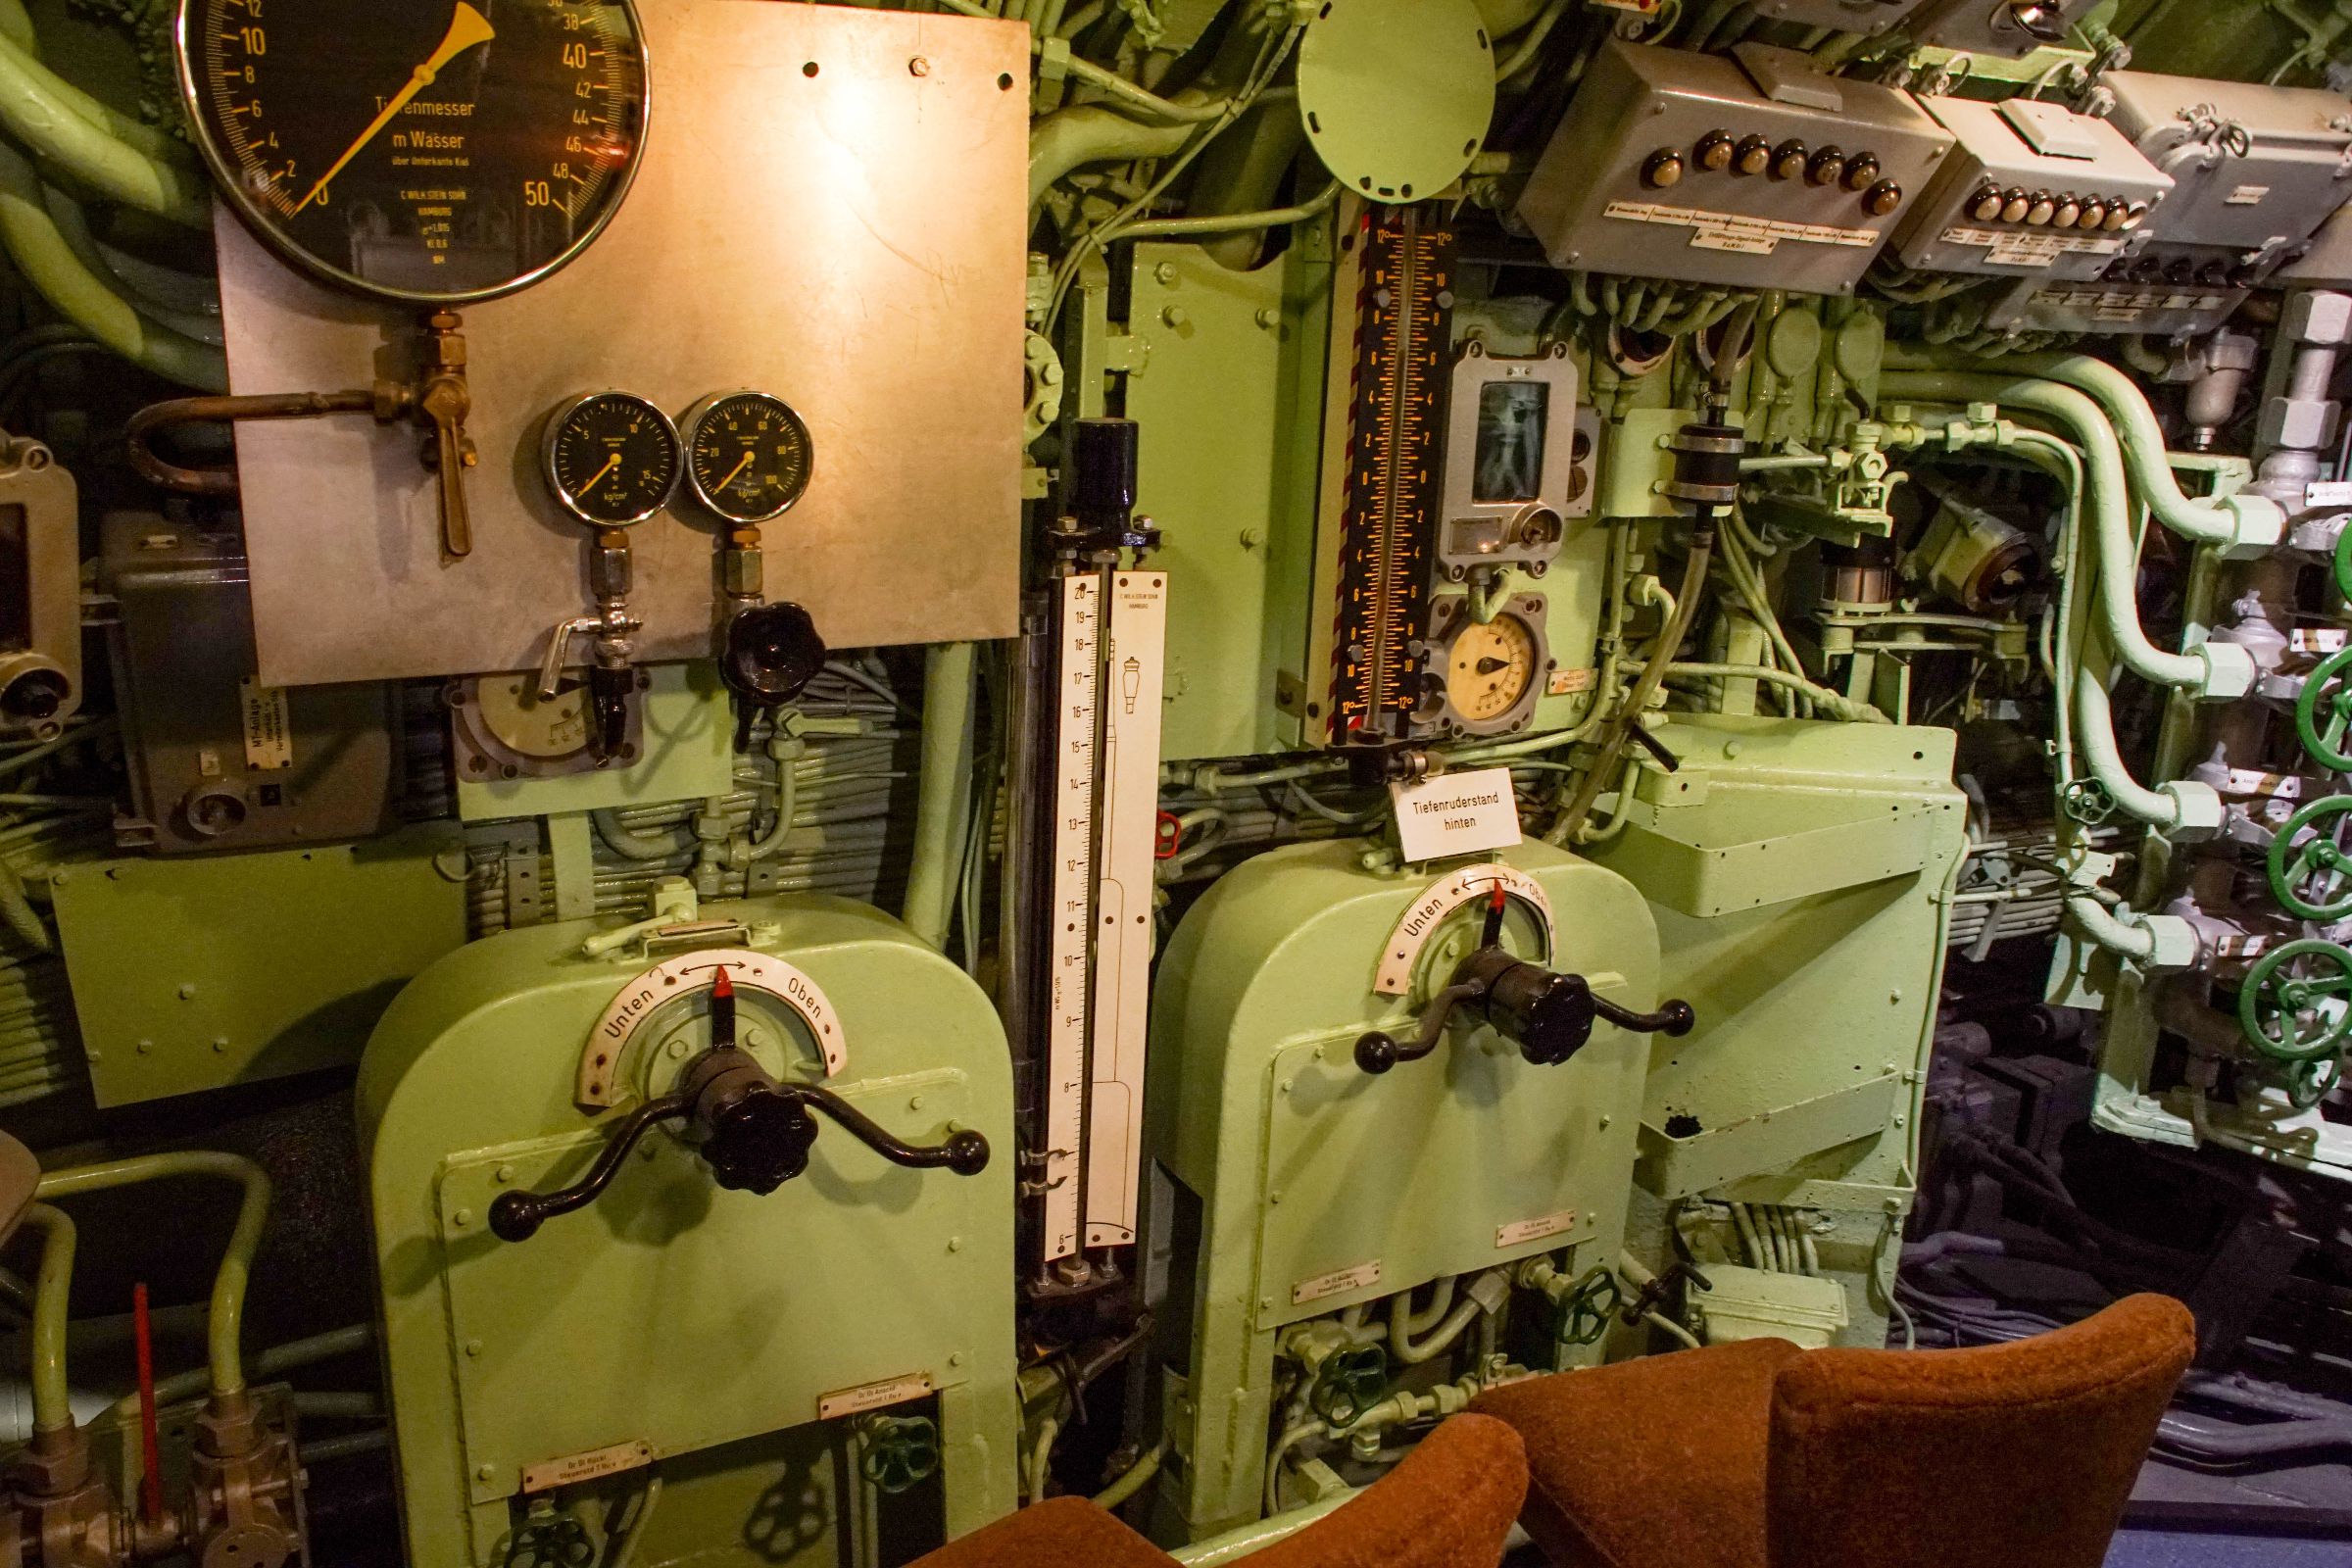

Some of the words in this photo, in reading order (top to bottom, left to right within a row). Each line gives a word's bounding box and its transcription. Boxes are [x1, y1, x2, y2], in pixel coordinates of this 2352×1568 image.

[248, 0, 264, 18] 12
[563, 13, 579, 31] 38
[240, 26, 267, 56] 10
[562, 43, 587, 70] 40
[244, 65, 256, 84] 8
[575, 81, 592, 99] 42
[251, 99, 263, 118] 6
[375, 95, 475, 117] Tienmesser
[572, 109, 589, 125] 44
[269, 130, 279, 149] 4
[393, 133, 407, 148] m
[410, 129, 466, 149] Wasser
[565, 135, 582, 153] 46
[286, 159, 297, 178] 2
[552, 162, 569, 179] 48
[523, 180, 550, 207] 50
[1436, 272, 1446, 287] 10
[1368, 390, 1374, 405] 4
[1427, 392, 1433, 406] 4
[582, 430, 590, 440] 5
[629, 422, 639, 434] 10
[1365, 433, 1371, 448] 2
[1424, 432, 1430, 446] 2
[1420, 469, 1426, 484] 0
[1359, 511, 1365, 525] 2
[1417, 510, 1424, 523] 2
[1356, 549, 1362, 563] 4
[1414, 546, 1420, 559] 4
[1353, 588, 1359, 602] 6
[1075, 610, 1085, 623] 19
[1074, 638, 1084, 651] 18
[1347, 664, 1355, 678] 10
[1404, 660, 1413, 673] 10
[1073, 671, 1083, 684] 17
[1072, 706, 1082, 718] 16
[1071, 741, 1080, 754] 15
[1069, 778, 1079, 790] 14
[1412, 791, 1499, 814] Tiefenruderstand
[1068, 817, 1078, 831] 13
[1444, 816, 1477, 831] hinten
[1066, 859, 1076, 871] 12
[1066, 900, 1075, 912] 11
[1404, 898, 1444, 937] Unten
[1063, 955, 1073, 967] 10
[787, 977, 822, 1019] Oben
[604, 989, 655, 1039] Unten
[1066, 1015, 1072, 1028] 9
[1063, 1082, 1069, 1094] 8
[1058, 1234, 1064, 1245] 6
